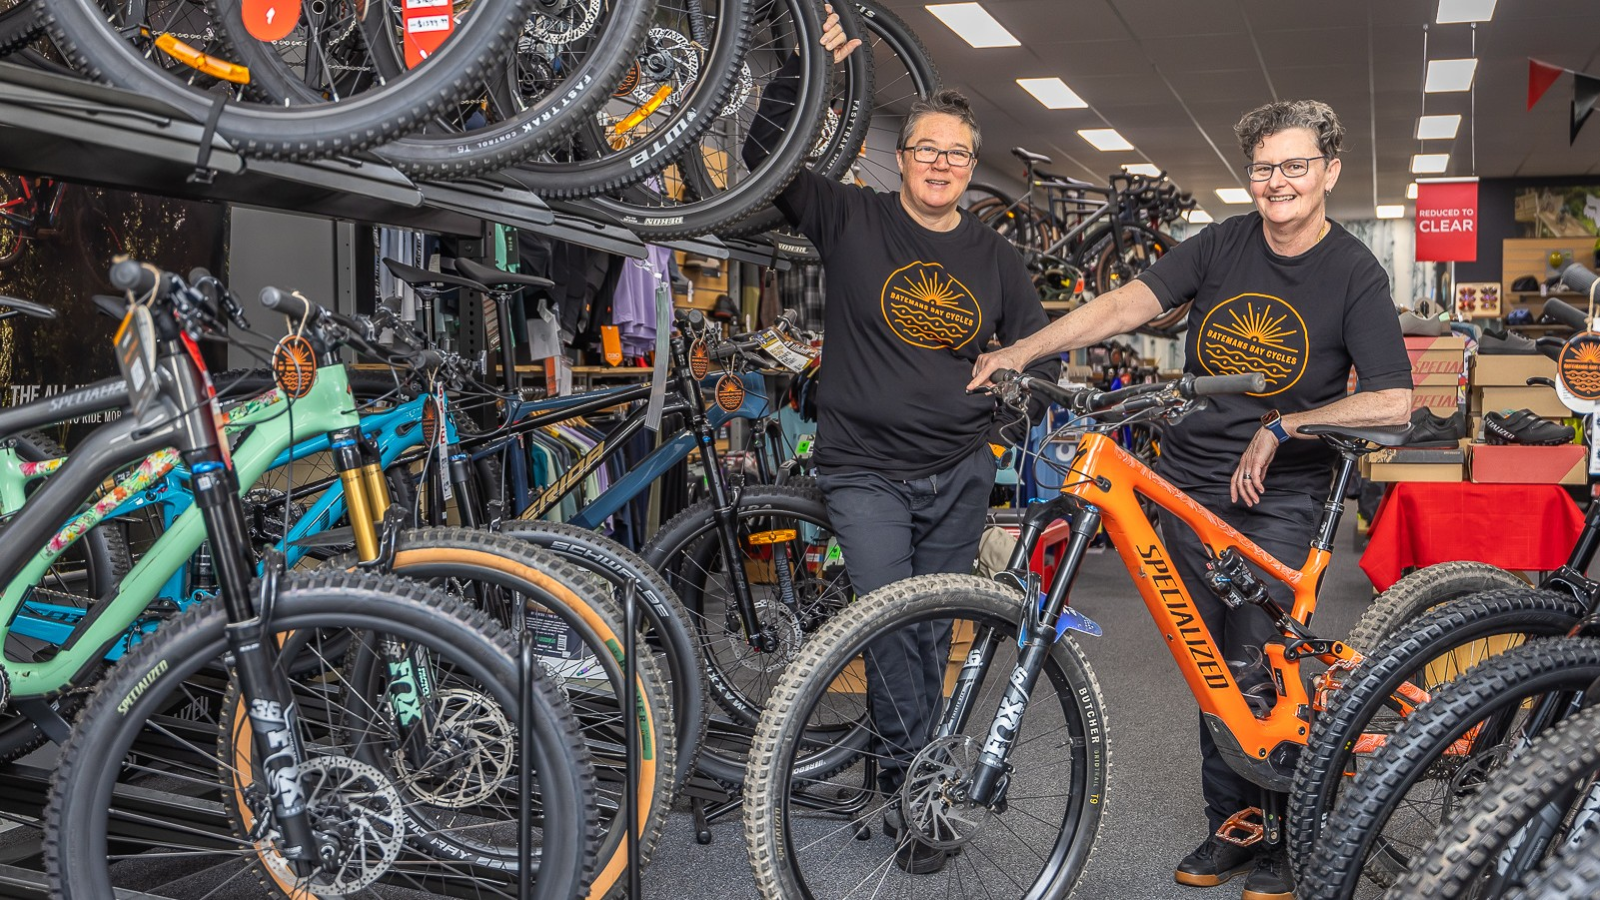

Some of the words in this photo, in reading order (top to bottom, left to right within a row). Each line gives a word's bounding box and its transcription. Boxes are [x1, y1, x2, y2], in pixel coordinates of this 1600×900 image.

[561, 74, 592, 107] FAST
[522, 107, 560, 133] TRAK
[849, 100, 860, 124] FAST
[477, 131, 517, 148] CONTROL
[629, 118, 689, 169] WTB
[838, 126, 853, 151] TRAK
[1419, 208, 1460, 217] REDUCED
[1461, 208, 1474, 217] TO
[1419, 219, 1474, 233] CLEAR
[890, 292, 928, 311] BATEMANS
[930, 306, 945, 317] BAY
[945, 312, 974, 327] CYCLES
[1206, 329, 1249, 350] BATEMANS
[1248, 344, 1266, 356] BAY
[1266, 351, 1298, 365] CYCLES
[517, 441, 605, 520] ERIDA
[1135, 544, 1230, 689] SPECIALIZED
[117, 659, 169, 716] SPECIALIZED
[388, 657, 423, 726] FOX
[983, 696, 1026, 760] FOX
[1079, 687, 1100, 744] BUTCHER
